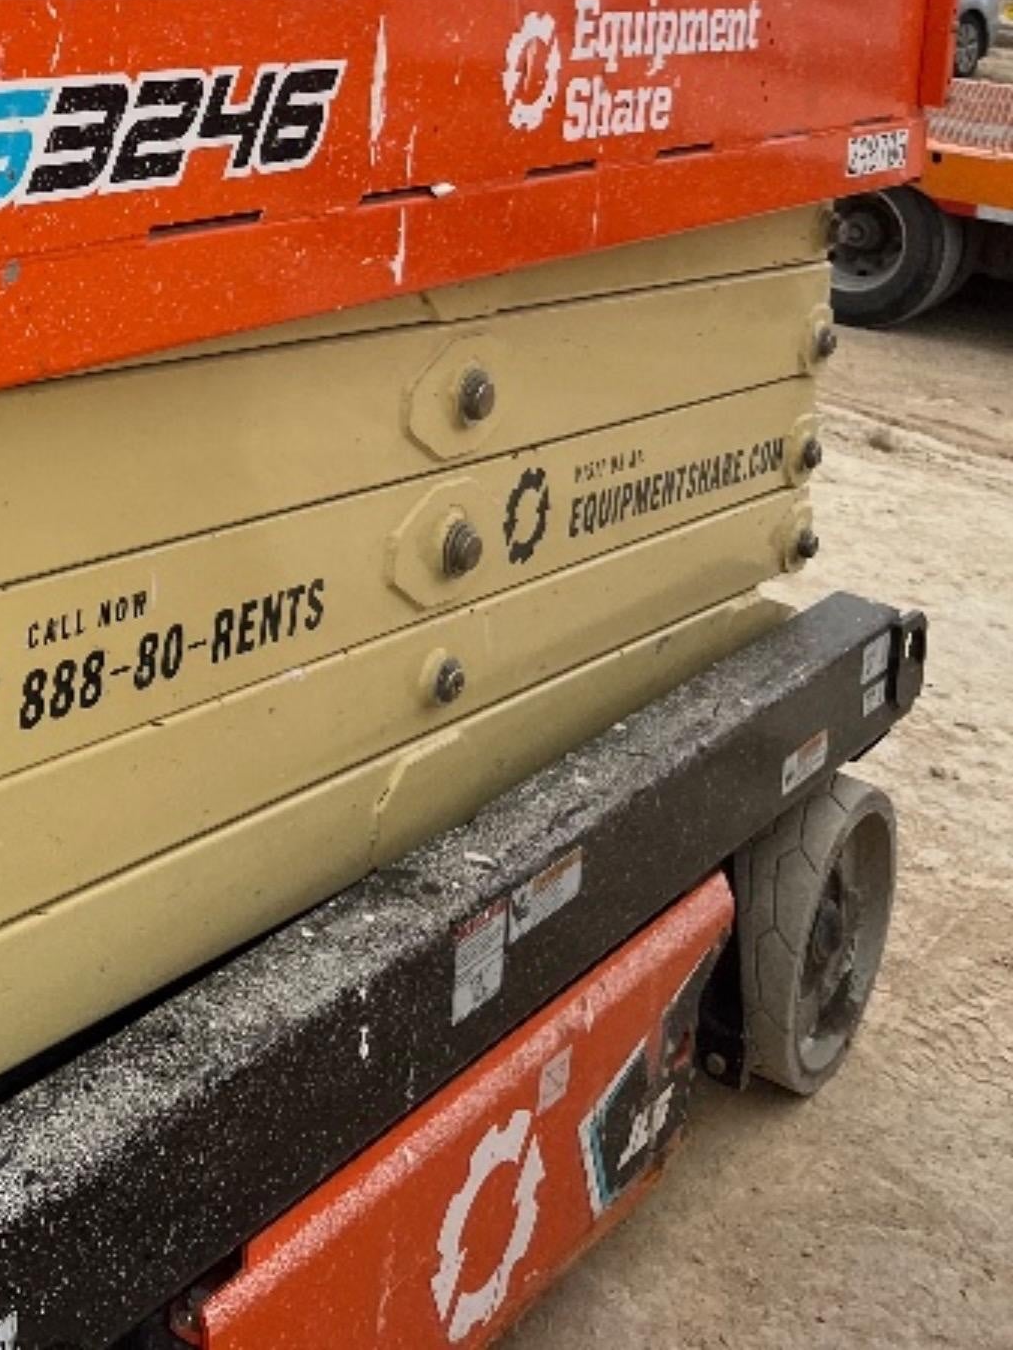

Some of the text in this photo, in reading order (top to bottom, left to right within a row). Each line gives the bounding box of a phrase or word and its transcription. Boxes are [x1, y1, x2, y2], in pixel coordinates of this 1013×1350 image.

[561, 76, 674, 142] Share
[568, 437, 786, 538] EQUIPMENTSHARE.COM
[19, 578, 325, 730] 888-80-RENTS
[27, 608, 86, 649] CALL
